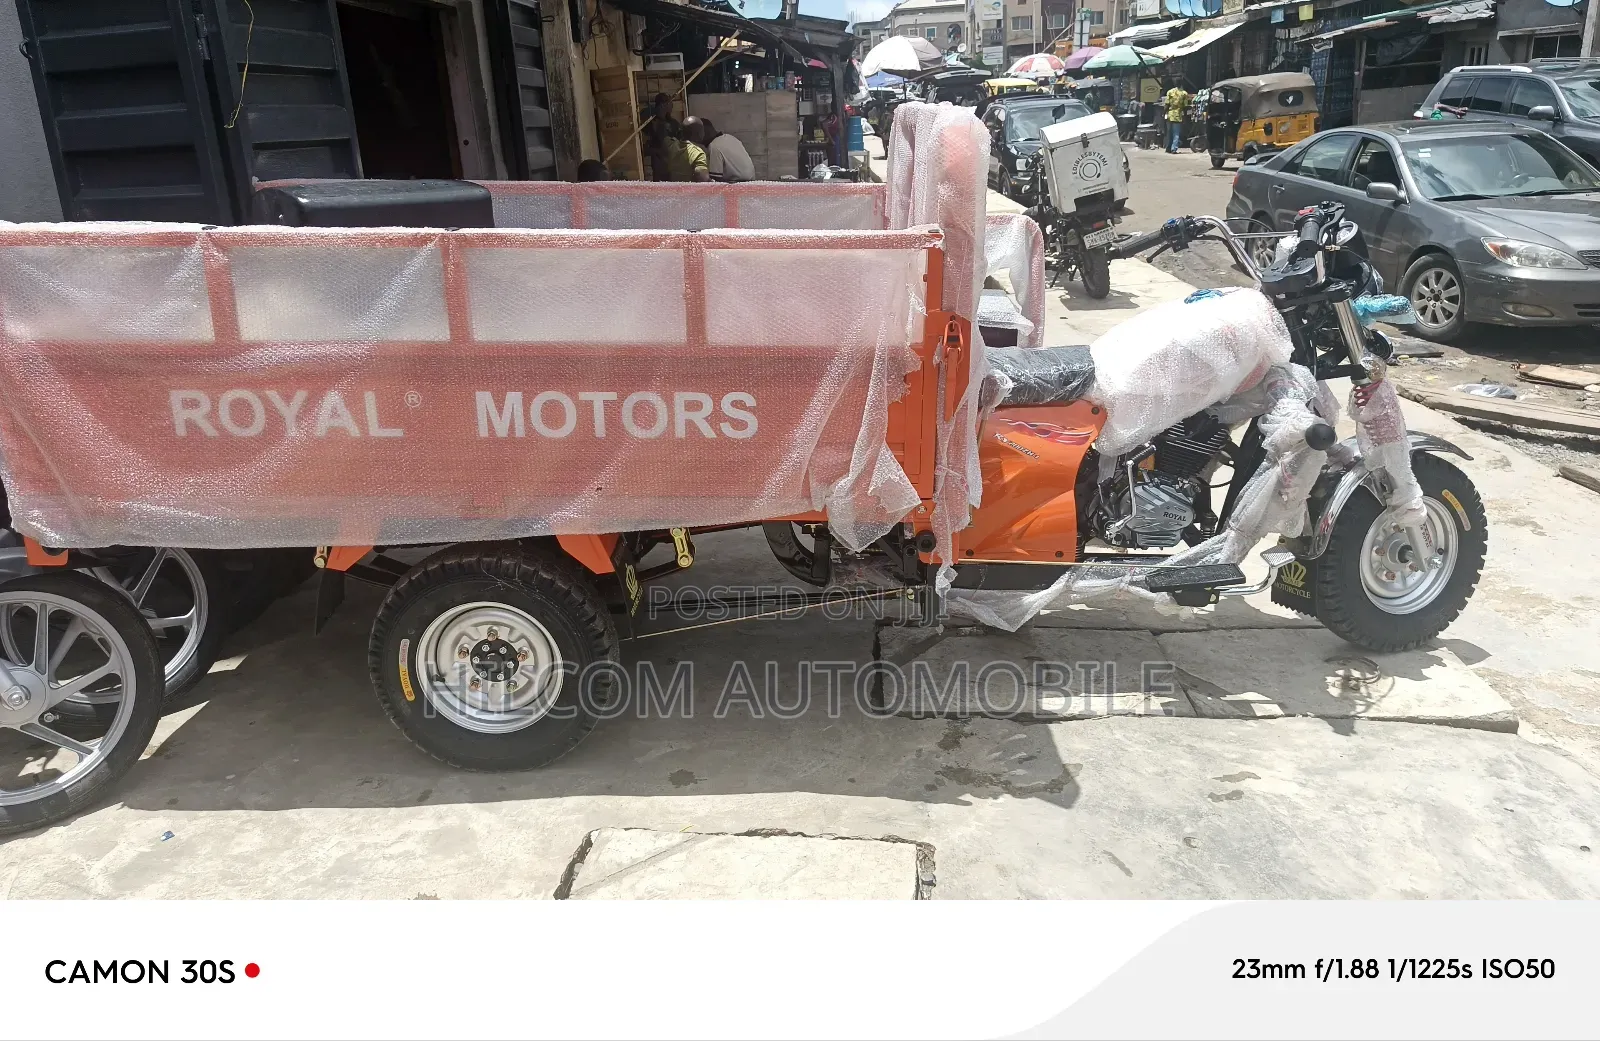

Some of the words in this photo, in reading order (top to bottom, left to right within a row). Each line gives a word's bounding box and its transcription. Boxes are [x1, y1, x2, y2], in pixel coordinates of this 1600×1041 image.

[1072, 151, 1108, 175] EDIBLESBYTEMI
[169, 389, 404, 438] ROYAL
[474, 390, 760, 441] MOTORS
[1162, 510, 1187, 522] ROYAL
